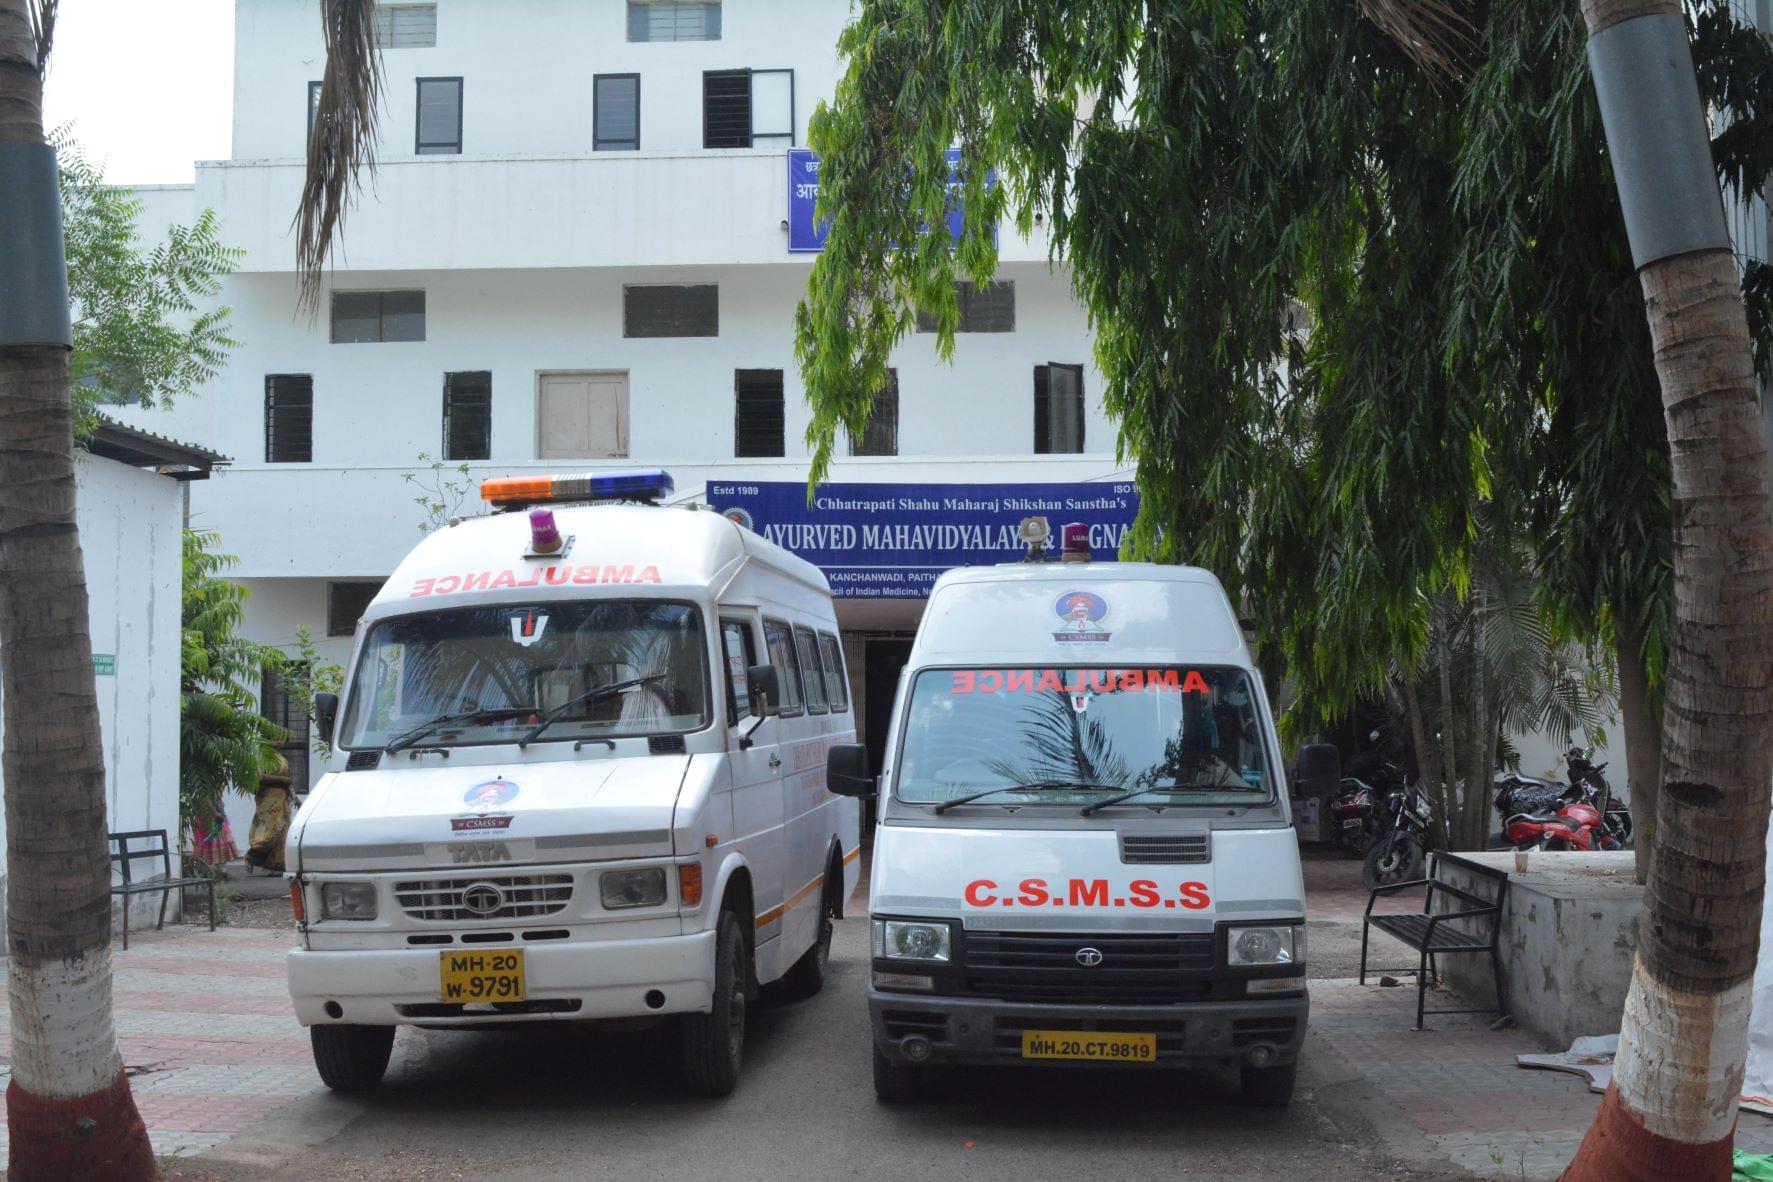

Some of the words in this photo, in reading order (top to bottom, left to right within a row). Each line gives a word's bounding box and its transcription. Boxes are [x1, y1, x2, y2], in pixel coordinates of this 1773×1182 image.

[713, 486, 735, 495] Estd
[738, 486, 759, 495] 1989
[1113, 484, 1131, 494] ISO
[816, 498, 895, 513] Chhatrapati
[899, 498, 940, 510] Shahu
[943, 498, 999, 513] Maharaj
[1003, 498, 1062, 510] Shikshan
[1065, 496, 1127, 510] Sanstha's
[763, 523, 857, 550] AYURVED
[830, 573, 906, 583] KANCHANWADI,
[845, 587, 854, 596] of
[855, 587, 880, 596] Indian
[882, 587, 921, 597] Medicine,
[447, 842, 513, 864] TATA
[964, 878, 1211, 910] C.S.M.S.S
